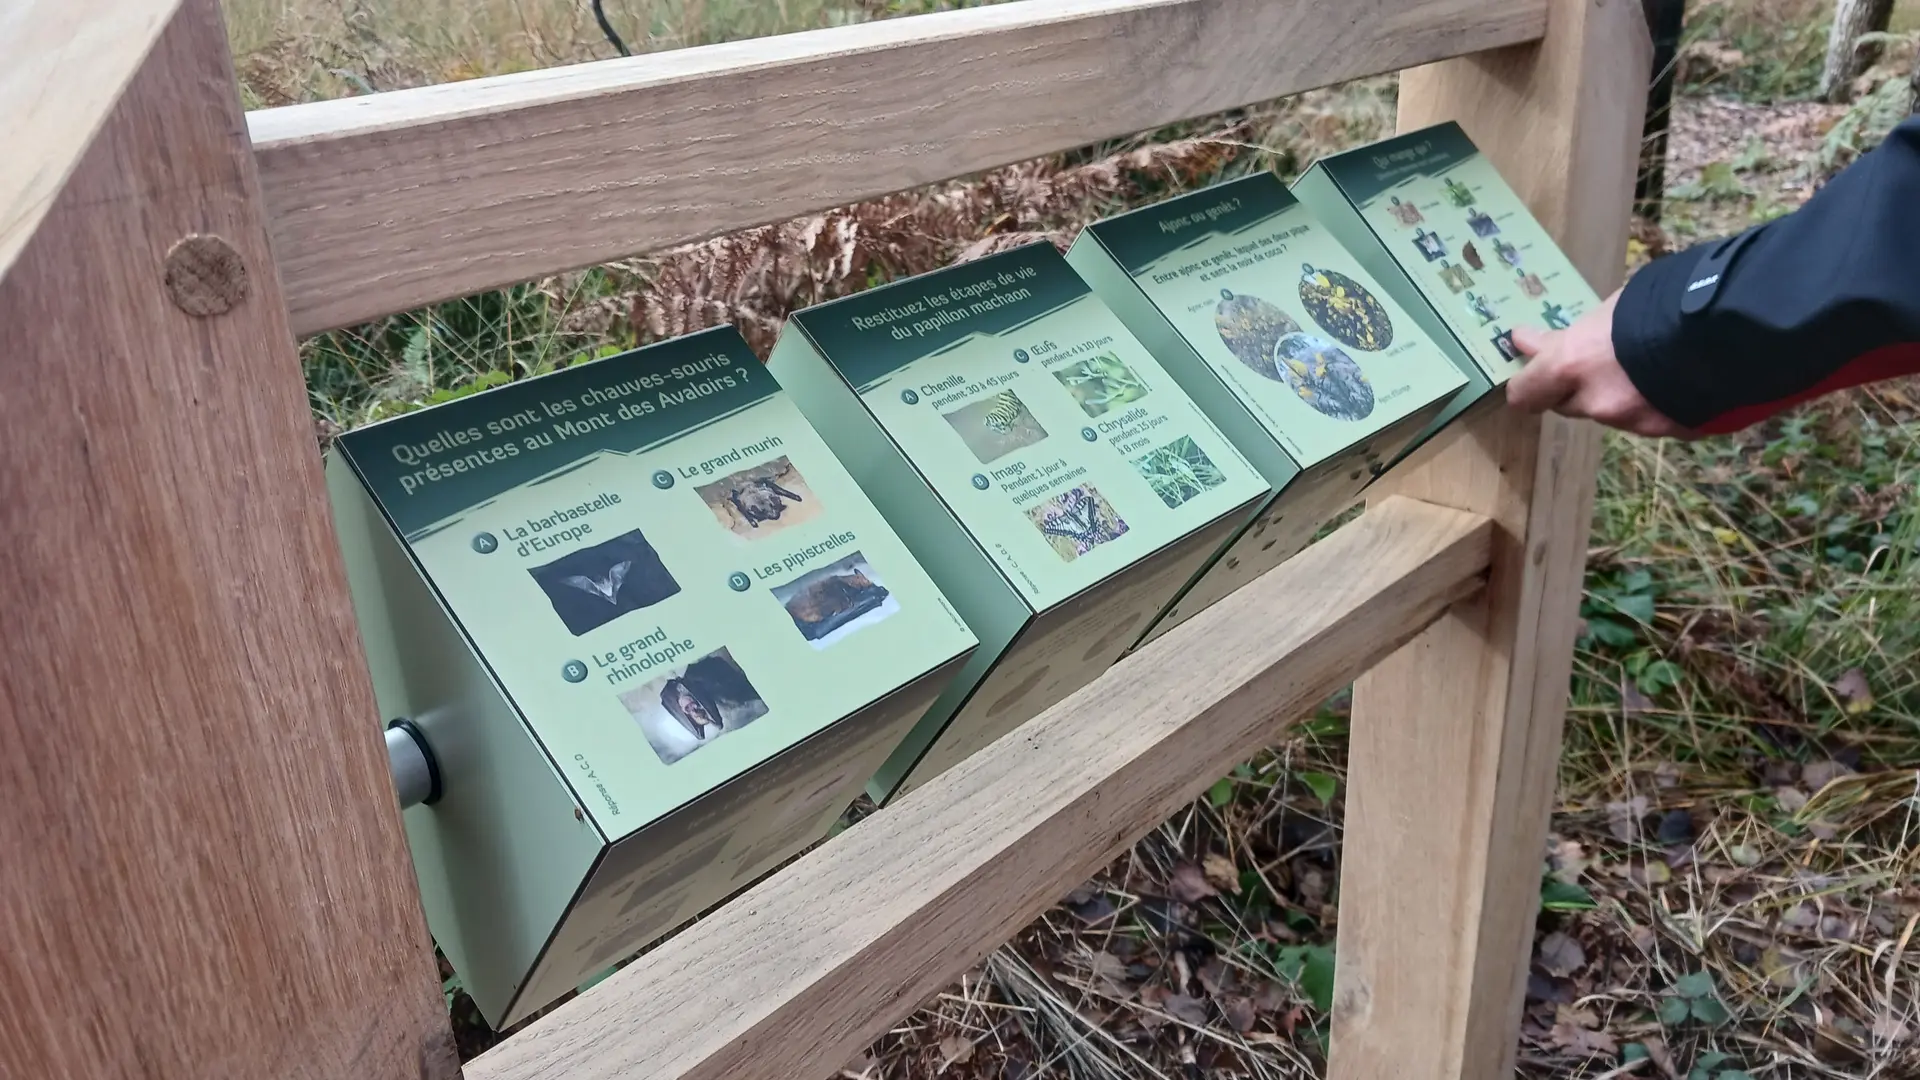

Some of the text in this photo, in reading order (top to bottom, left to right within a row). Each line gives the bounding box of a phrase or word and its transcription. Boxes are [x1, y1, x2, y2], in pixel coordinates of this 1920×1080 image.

[1158, 197, 1242, 234] Ajonc ou genêt ?
[1152, 269, 1179, 285] Entre
[1178, 263, 1201, 277] ajonc
[1200, 257, 1211, 267] et
[1233, 240, 1259, 255] lequel
[1199, 271, 1210, 282] et
[1229, 261, 1238, 271] la
[1237, 256, 1254, 269] noix
[1252, 252, 1266, 262] de
[1280, 243, 1289, 252] ?
[851, 264, 1037, 331] Restituez les étapes de vie
[891, 287, 1032, 341] du papillon machaon
[1030, 340, 1058, 356] Œufs
[1041, 349, 1073, 368] pendant
[1082, 341, 1094, 351] 10
[1092, 335, 1113, 349] jours
[920, 374, 966, 397] Chenille
[932, 370, 1020, 410] pendant 30 à 45 jours
[392, 353, 731, 466] Quelles sont les chauves-souris
[1098, 407, 1148, 433] Chrysalide
[399, 367, 749, 496] présentes au Mont des Avaloirs ?
[1108, 415, 1168, 447] pendant 15 jours
[1123, 444, 1132, 453] 8
[1132, 436, 1151, 450] mois
[677, 466, 699, 479] Le
[700, 448, 741, 475] grand
[741, 436, 783, 458] murin
[989, 461, 1027, 481] Imago
[1000, 458, 1068, 493] Pendant 1 jour à
[1012, 465, 1087, 506] quelques semaines
[503, 527, 528, 541] La
[527, 493, 621, 533] barbastelle
[517, 523, 592, 557] d'Europe
[753, 562, 782, 580] Les
[782, 530, 856, 572] pipistrelles
[592, 652, 618, 668] Le
[619, 626, 668, 661] grand
[606, 639, 695, 685] rhinolophe
[596, 783, 620, 816] Réponse
